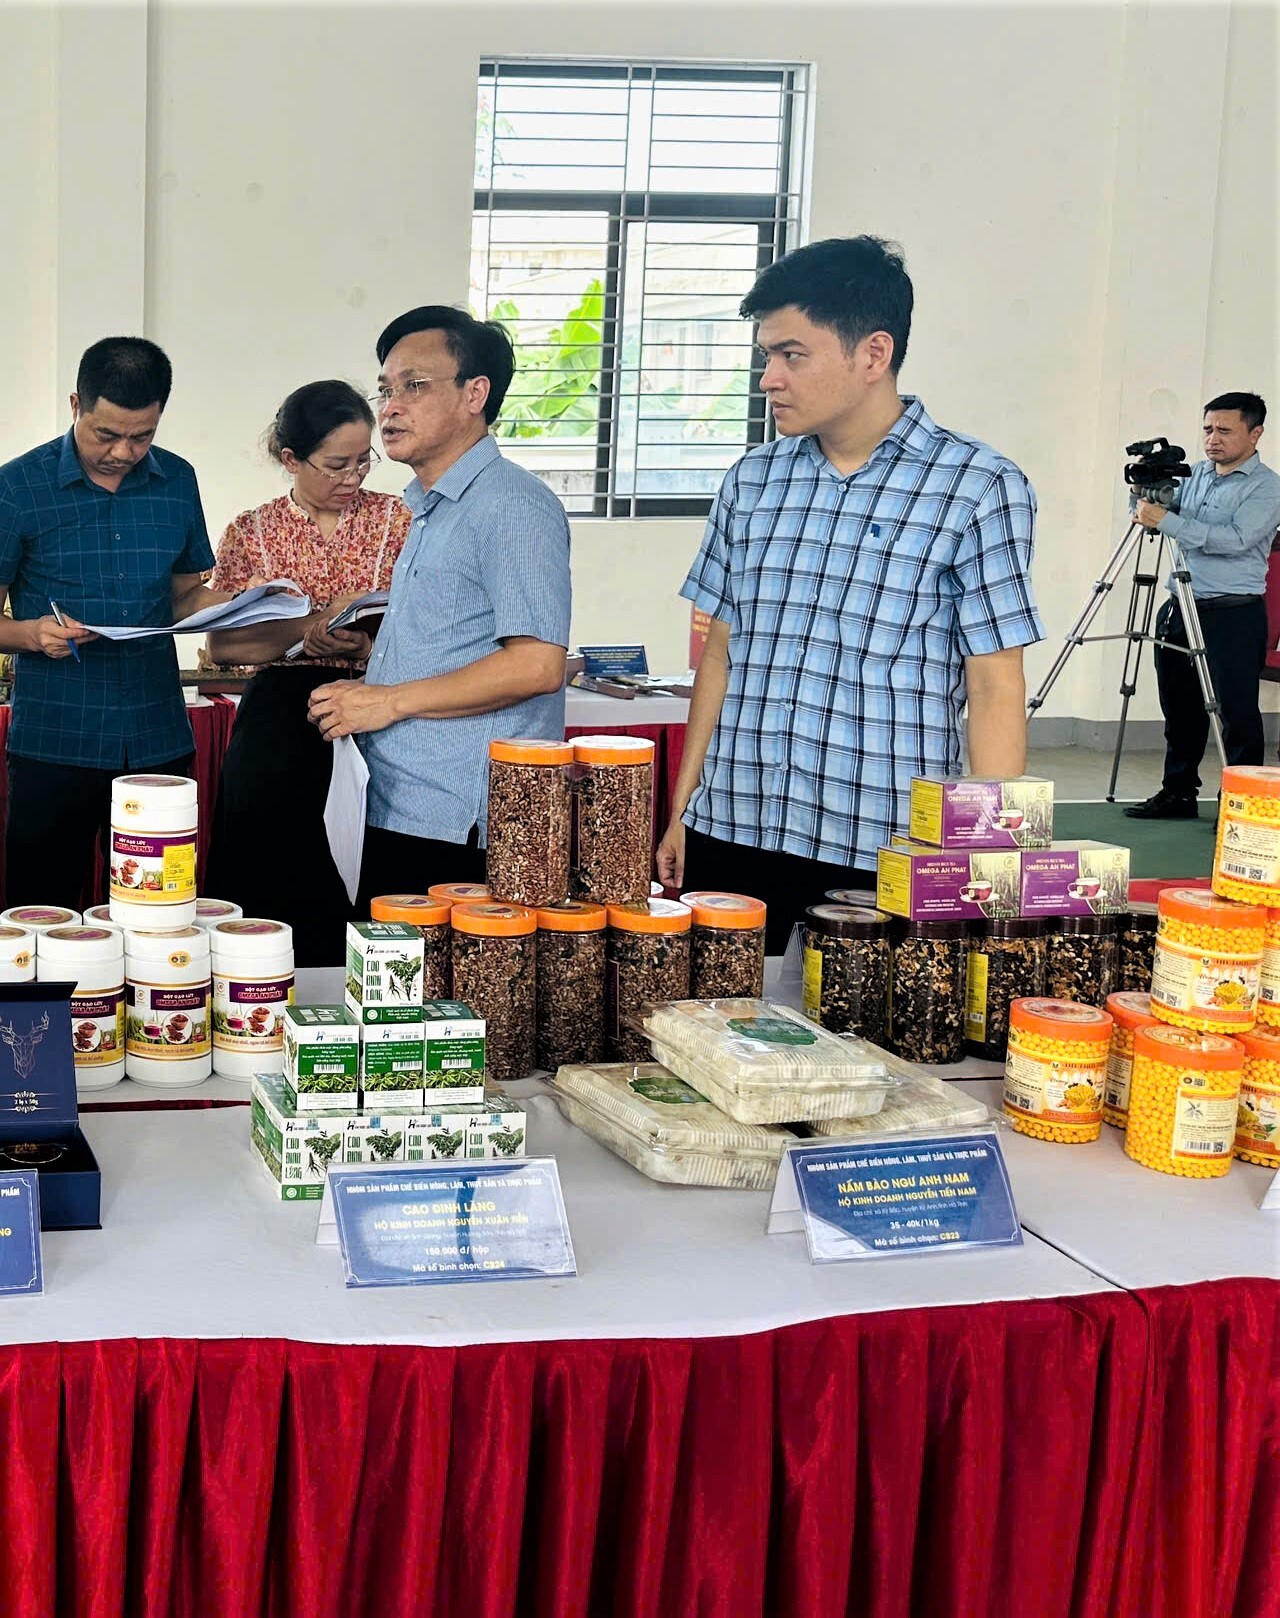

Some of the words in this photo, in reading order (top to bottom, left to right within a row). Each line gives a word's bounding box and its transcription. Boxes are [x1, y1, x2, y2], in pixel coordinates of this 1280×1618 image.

[837, 1179, 864, 1193] NẤM
[865, 1178, 889, 1191] BÀO
[891, 1176, 916, 1188] NGƯ
[919, 1174, 942, 1186] ANH
[943, 1172, 970, 1184] NAM
[837, 1196, 851, 1208] HỘ
[852, 1197, 873, 1206] KINH
[874, 1193, 904, 1203] DOANH
[905, 1188, 938, 1201] NGUYỄN
[957, 1186, 977, 1196] NAM
[402, 1203, 429, 1216] CAO
[431, 1202, 461, 1214] ĐINH
[463, 1199, 496, 1212] LĂNG
[373, 1219, 388, 1232] HỘ
[390, 1219, 412, 1230] KINH
[413, 1217, 446, 1228] DOANH
[890, 1221, 900, 1229] 35
[906, 1218, 939, 1229] 40k/1kg
[472, 1245, 489, 1256] hộp
